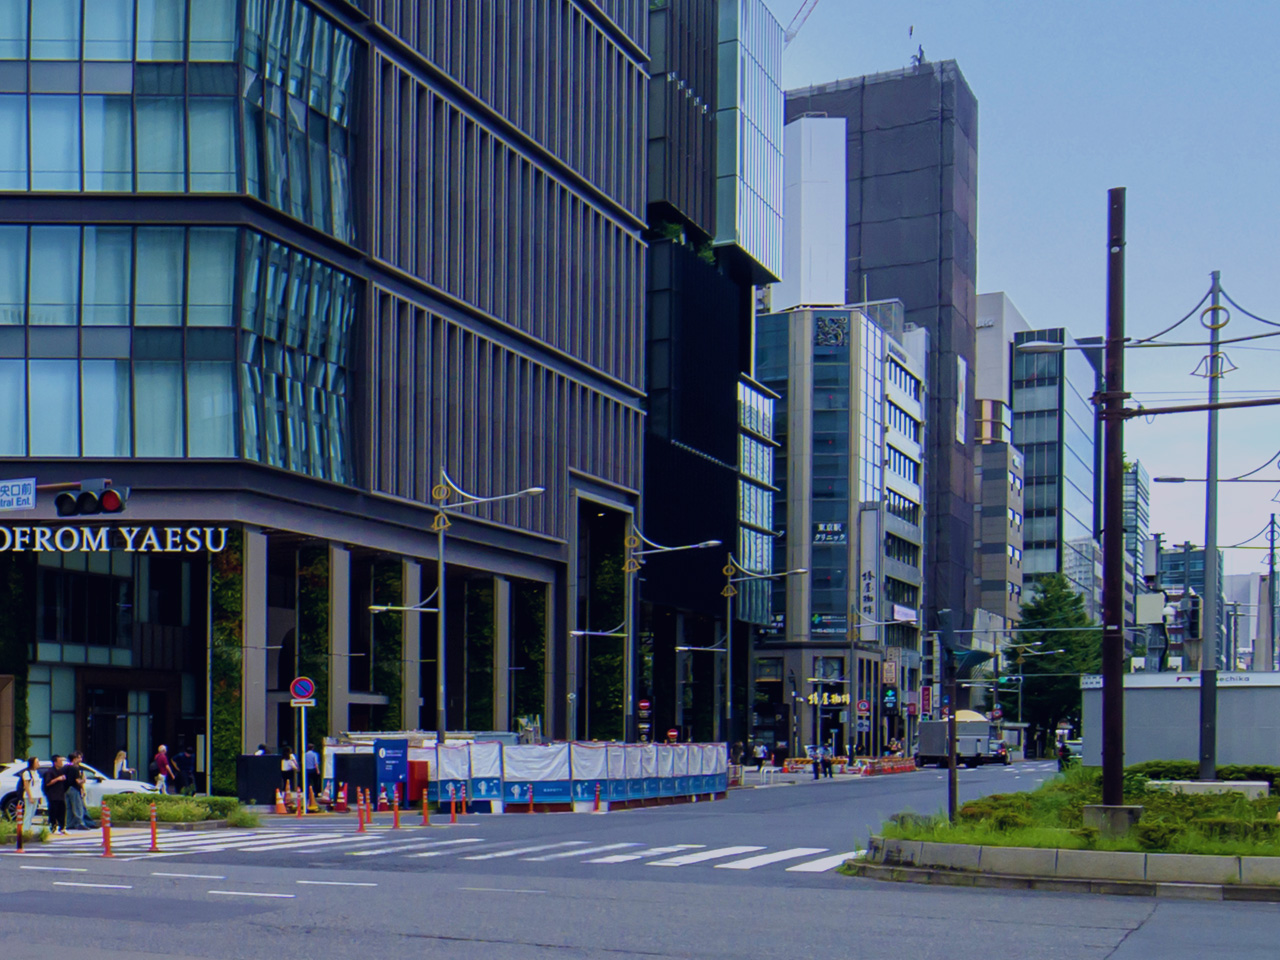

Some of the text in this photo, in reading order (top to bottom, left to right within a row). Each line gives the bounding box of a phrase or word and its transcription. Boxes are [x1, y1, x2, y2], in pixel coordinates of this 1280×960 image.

[817, 523, 842, 532] 東京駅
[119, 526, 229, 552] YAESU
[814, 533, 846, 542] クリニック
